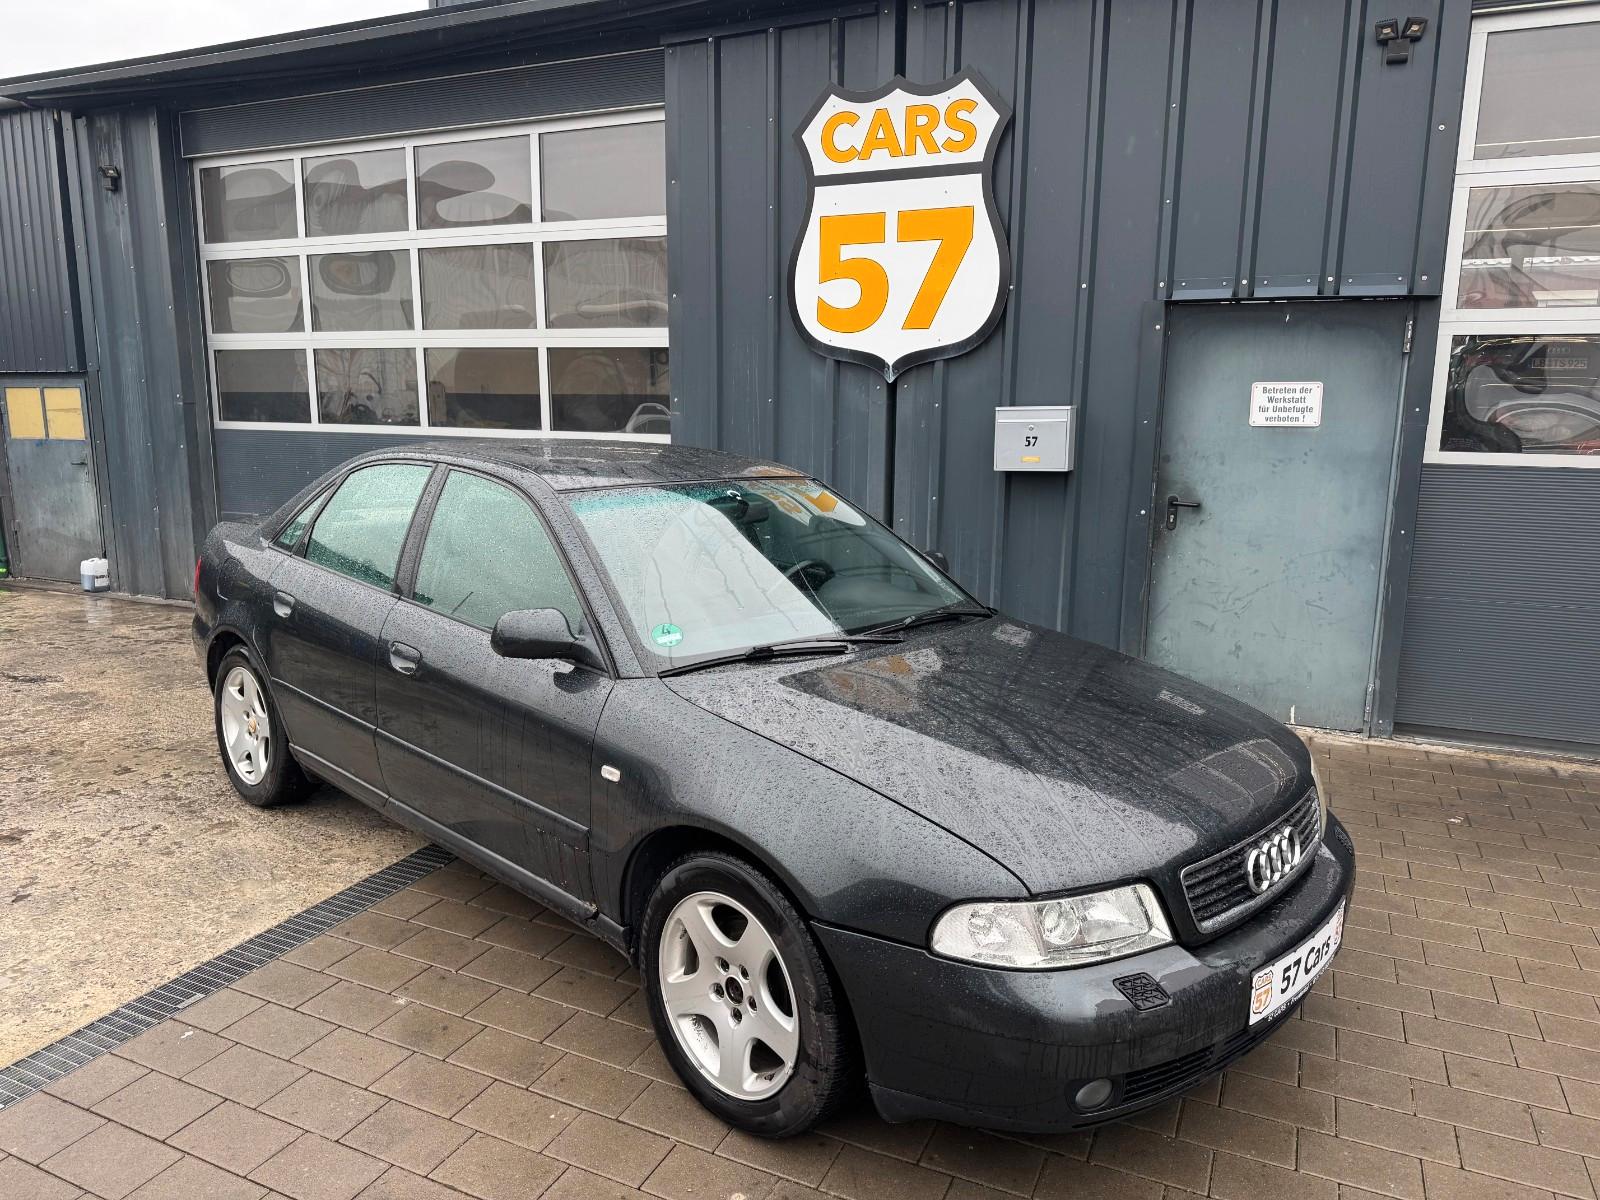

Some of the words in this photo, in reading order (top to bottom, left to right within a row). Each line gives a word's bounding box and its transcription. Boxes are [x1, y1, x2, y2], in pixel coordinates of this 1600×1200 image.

[821, 98, 978, 163] CARS
[816, 205, 975, 333] 57
[1262, 386, 1297, 395] Betreten
[1299, 386, 1313, 395] der
[1267, 396, 1307, 404] Werkstatt
[1258, 405, 1270, 413] für
[1272, 405, 1314, 414] Unbefugte
[1024, 436, 1038, 447] 57
[1281, 957, 1302, 995] 57
[1303, 935, 1332, 976] Cars
[1256, 974, 1272, 988] CARS
[1254, 988, 1270, 1011] 57
